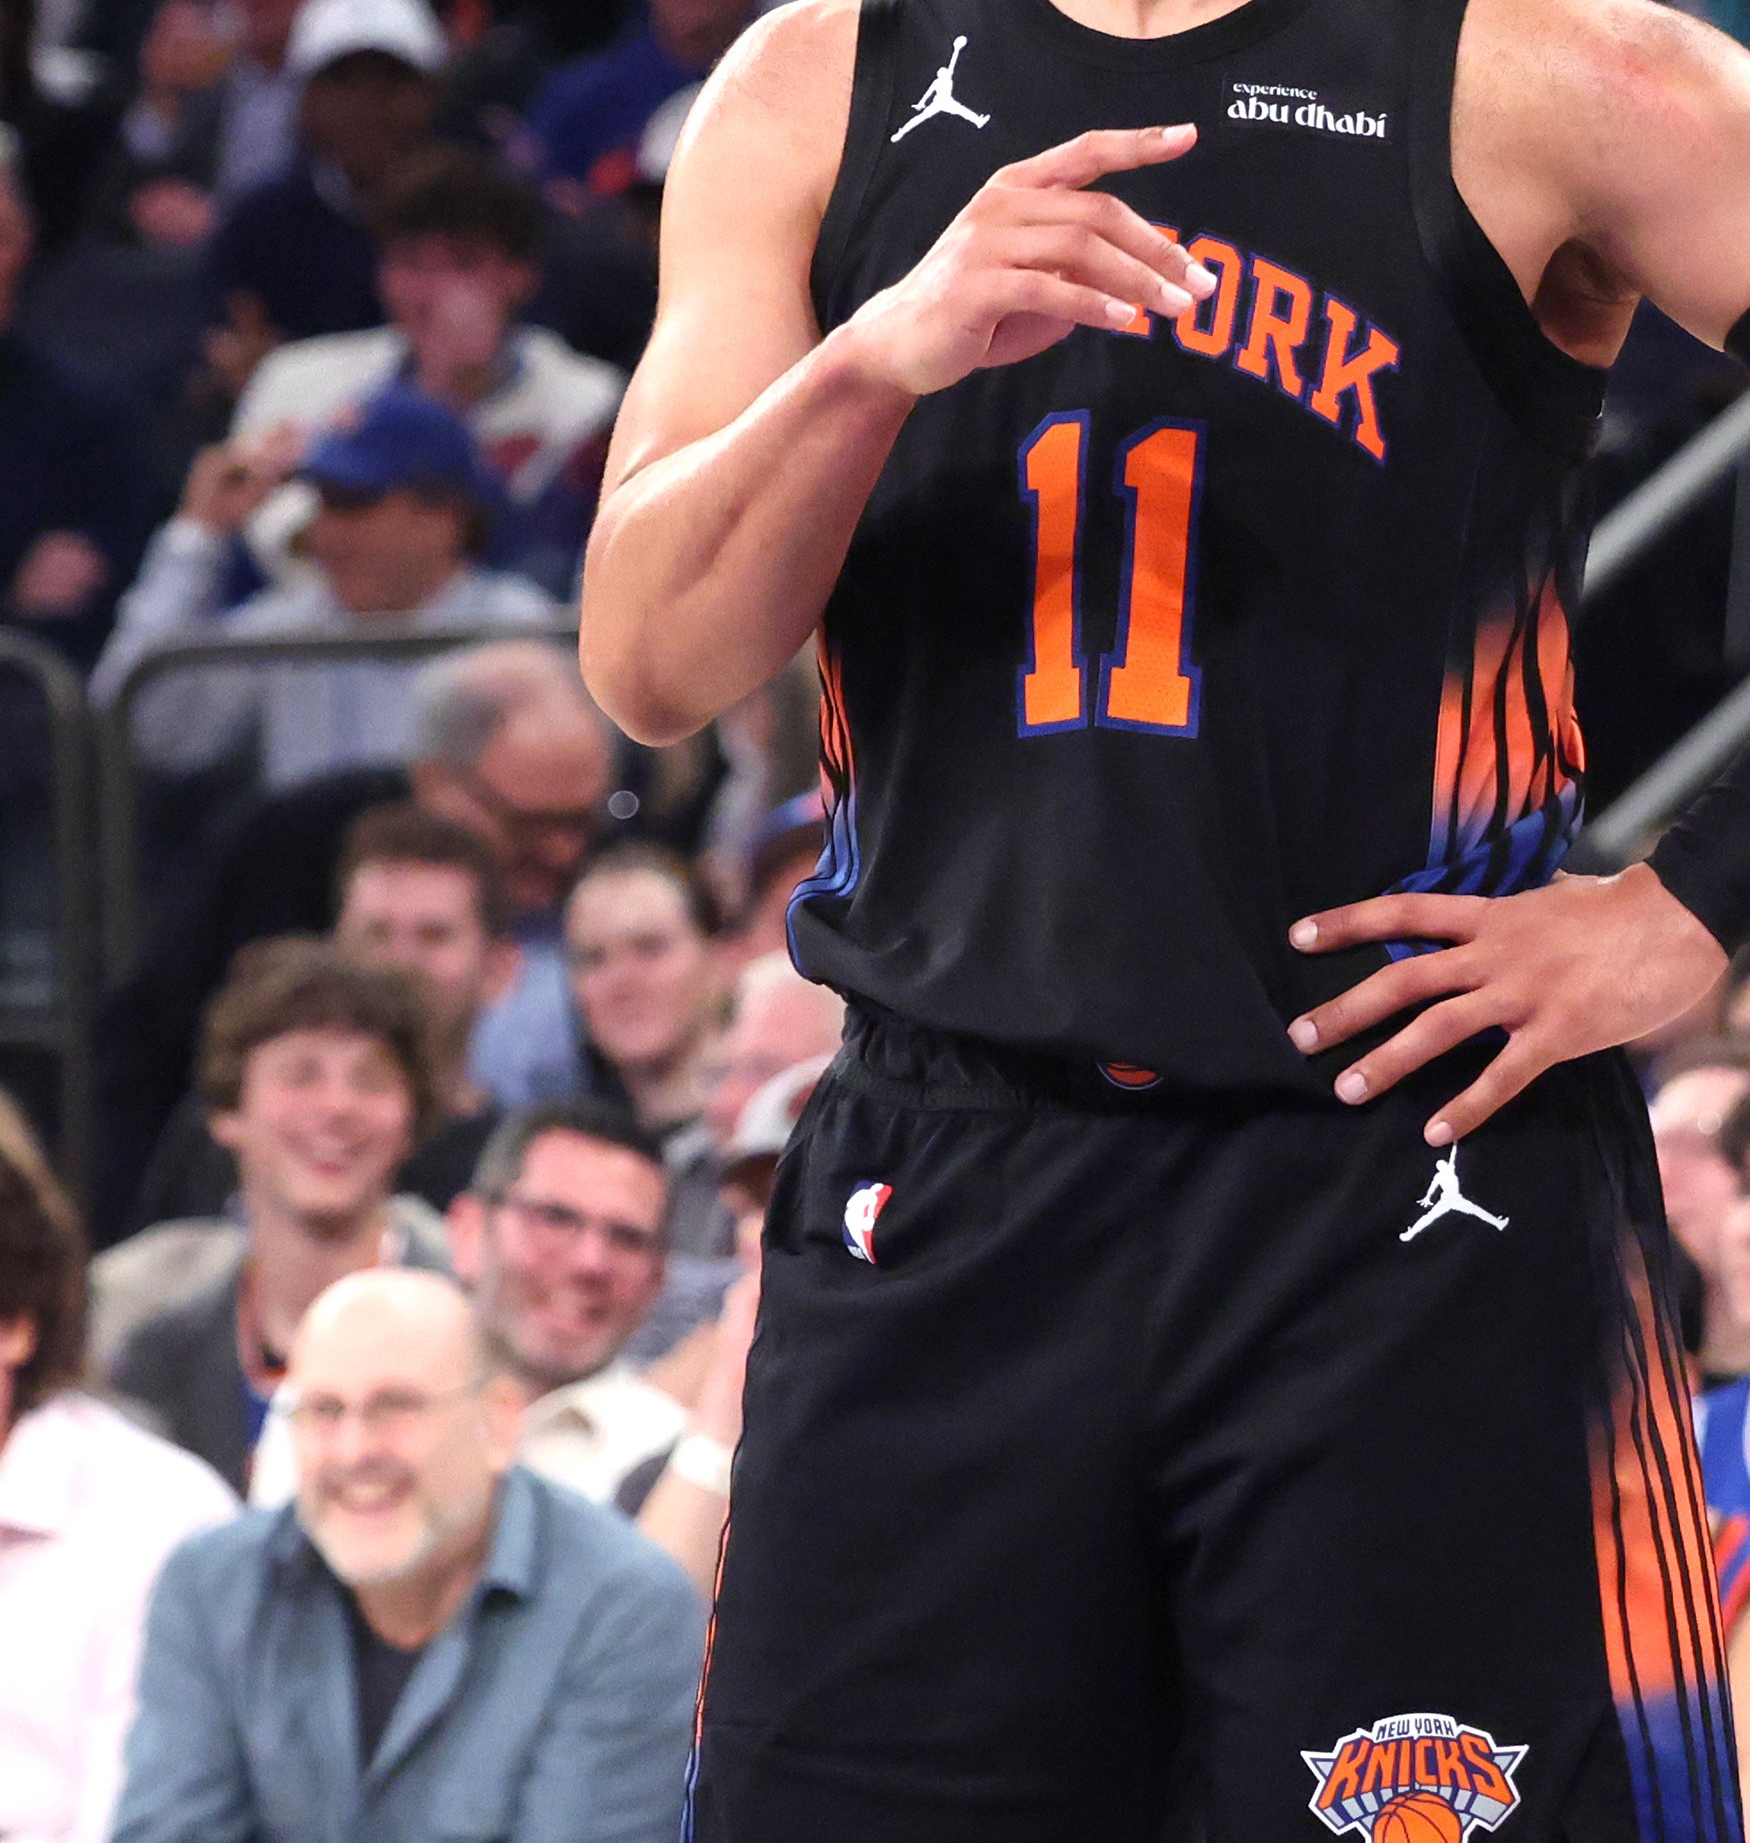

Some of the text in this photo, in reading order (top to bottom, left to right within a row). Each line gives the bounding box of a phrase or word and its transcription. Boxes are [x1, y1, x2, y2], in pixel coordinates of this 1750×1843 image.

[1232, 82, 1319, 101] experience
[1227, 96, 1290, 124] abu
[1016, 408, 1210, 739] 11
[1375, 1717, 1456, 1741] NEW YORK
[1317, 1730, 1517, 1812] KNICKS
